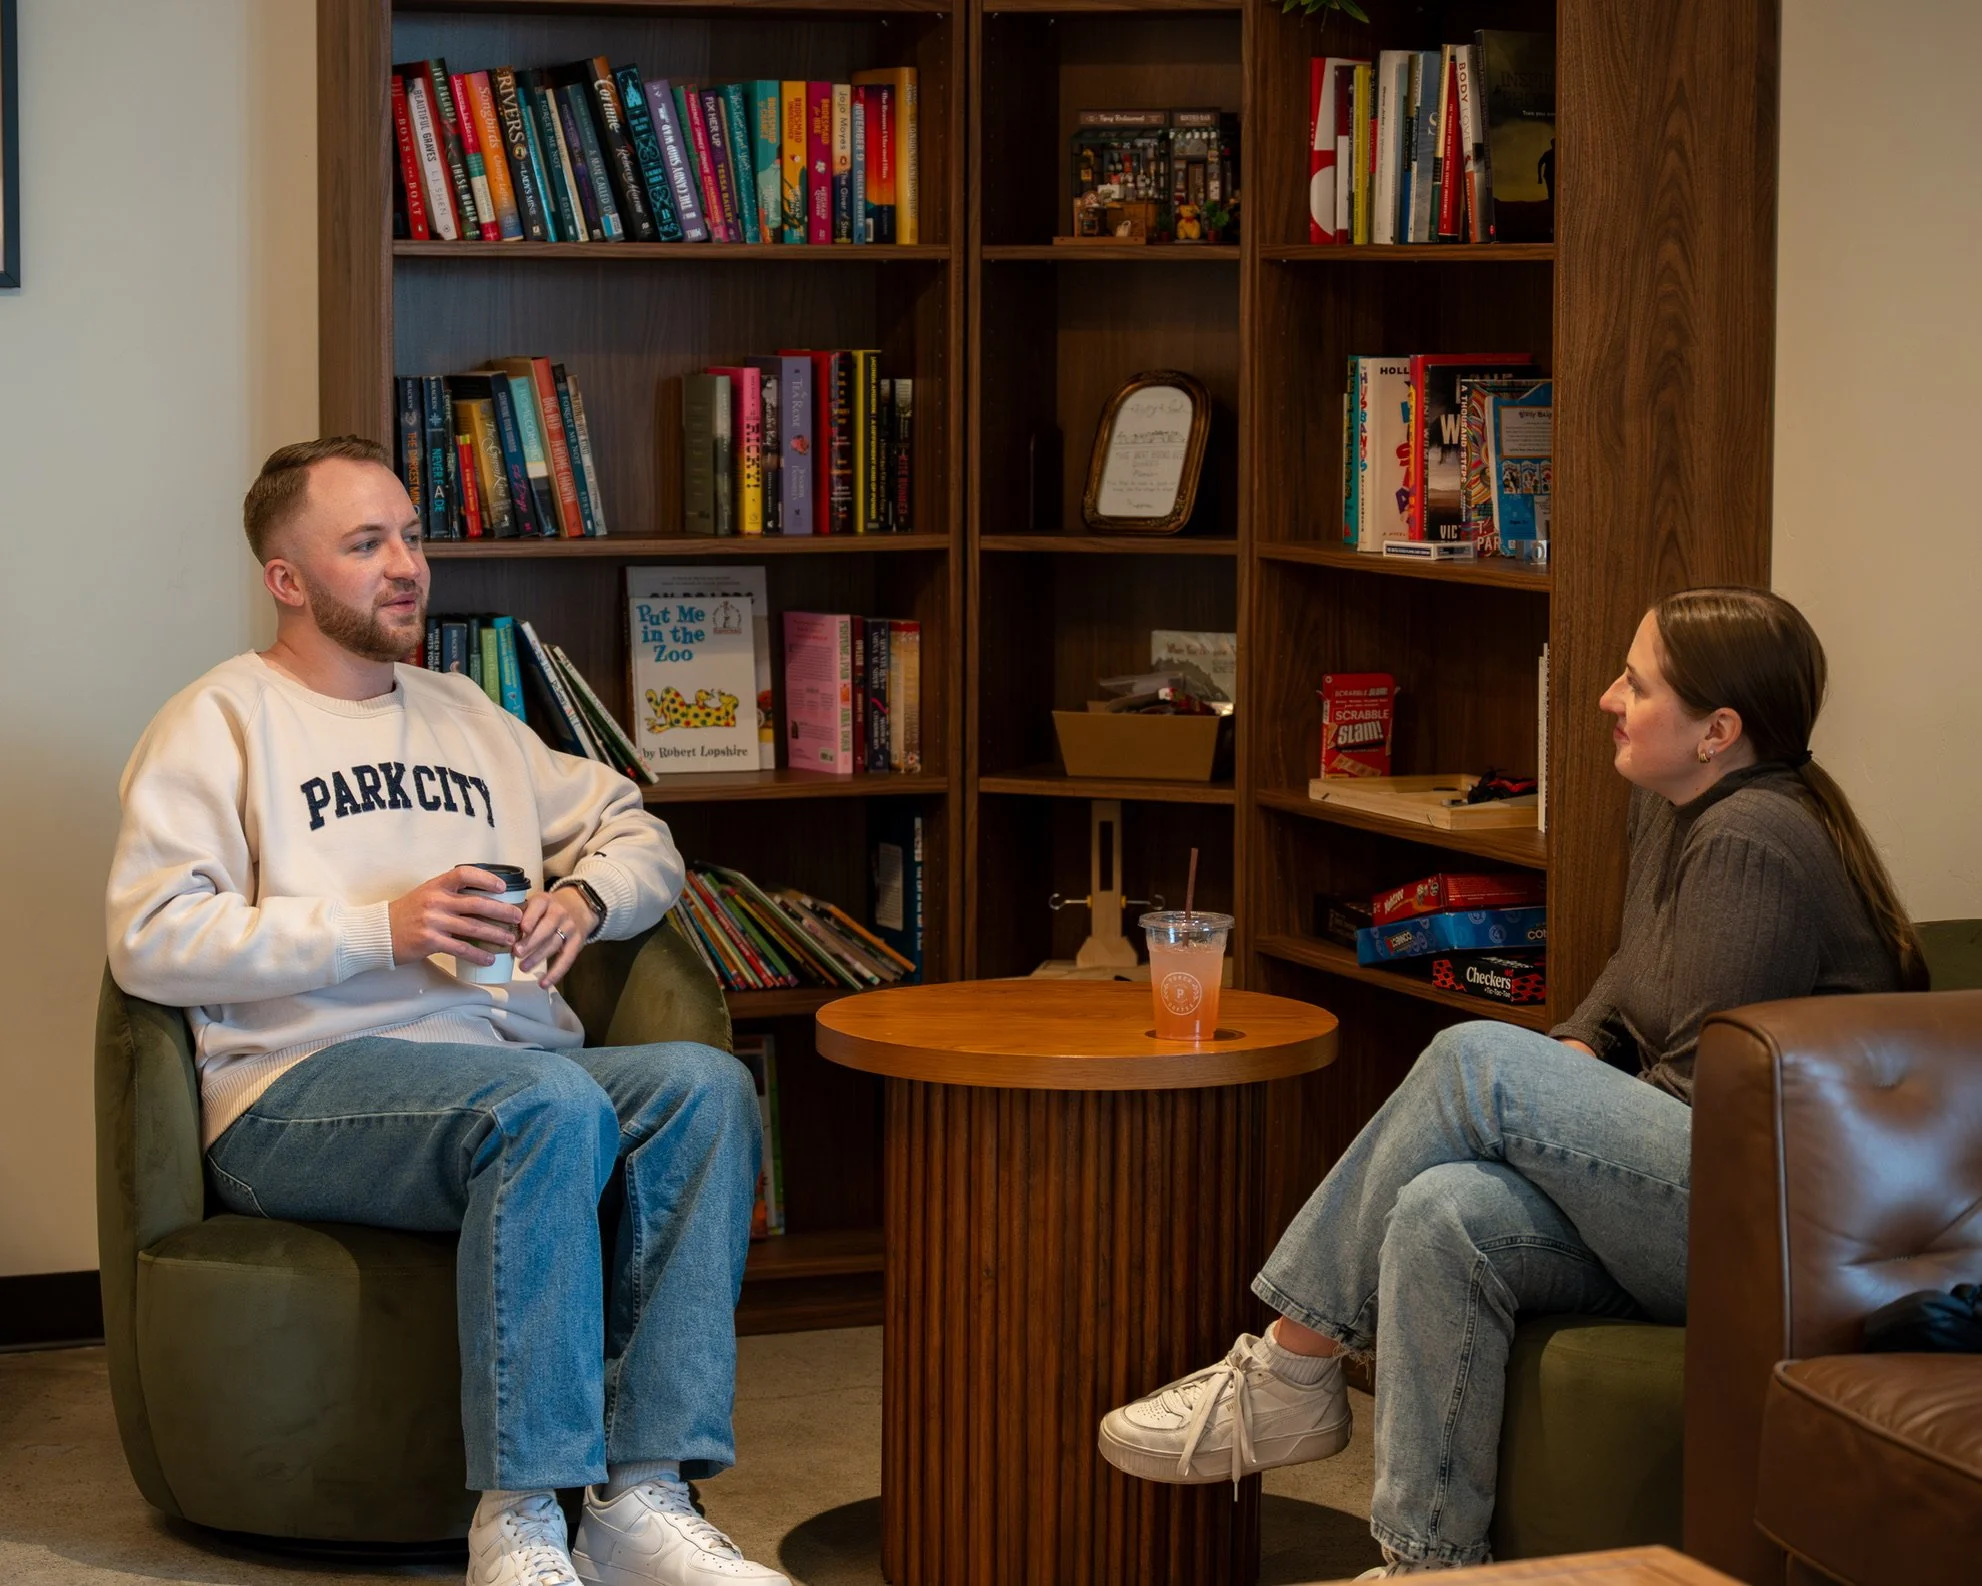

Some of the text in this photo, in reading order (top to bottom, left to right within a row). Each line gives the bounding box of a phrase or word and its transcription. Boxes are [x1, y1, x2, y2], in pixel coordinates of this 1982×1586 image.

[432, 67, 444, 81] IVY
[497, 74, 525, 143] RIVERS
[540, 100, 553, 132] FORGET
[594, 74, 626, 135] Corinne
[1458, 62, 1470, 141] BODY LOVE
[414, 89, 437, 162] BEAUTIFUL GRAVES
[476, 85, 501, 149] Songbirds
[704, 96, 722, 148] FIX HER UP
[794, 98, 802, 142] BRIDESMAID
[821, 98, 830, 144] BRIDESMAID
[838, 92, 847, 150] Jojo Moyes
[856, 103, 864, 150] NOVEMBER
[548, 135, 557, 148] ME
[666, 143, 682, 167] SHOP
[398, 118, 421, 216] BOYS BOAT
[552, 150, 561, 170] NOT
[591, 156, 602, 176] MAN
[615, 144, 638, 183] Rebecca
[452, 163, 478, 222] THESE WOMEN
[596, 176, 609, 204] CALLED
[672, 166, 689, 194] CANDY
[716, 163, 733, 223] TESSA BAILEY
[434, 187, 448, 216] SHEN
[561, 196, 571, 220] EDEN
[678, 193, 693, 210] THE
[840, 188, 848, 209] Giver
[1380, 367, 1410, 375] HOLL
[430, 381, 438, 410] BRACKEN
[792, 377, 803, 428] TEA ROSE
[518, 387, 541, 461] HOMECOMING
[542, 396, 560, 431] BIG RED
[562, 396, 573, 428] FORGET
[1360, 372, 1368, 472] HUSBANDS
[569, 431, 577, 444] ME
[763, 430, 775, 446] Key
[408, 432, 419, 484] THE DARKEST
[572, 446, 581, 465] NOT
[746, 422, 760, 488] RICKY!
[432, 448, 445, 513] NEVER FADE
[550, 439, 575, 504] JEROME CHARYN
[871, 482, 876, 491] OF
[898, 455, 908, 514] KITE RUNNER
[512, 479, 532, 514] Days
[580, 491, 590, 515] EDEN
[1478, 520, 1487, 534] T.
[1477, 536, 1501, 552] PAR
[636, 604, 705, 626] Put Me
[641, 626, 705, 644] in the
[653, 644, 693, 662] Zoo
[1335, 708, 1390, 721] SCRABBLE
[643, 744, 748, 760] by Robert Lopshire
[300, 762, 495, 831] PARK CITY
[1466, 966, 1511, 990] Checkers
[1177, 988, 1184, 999] P
